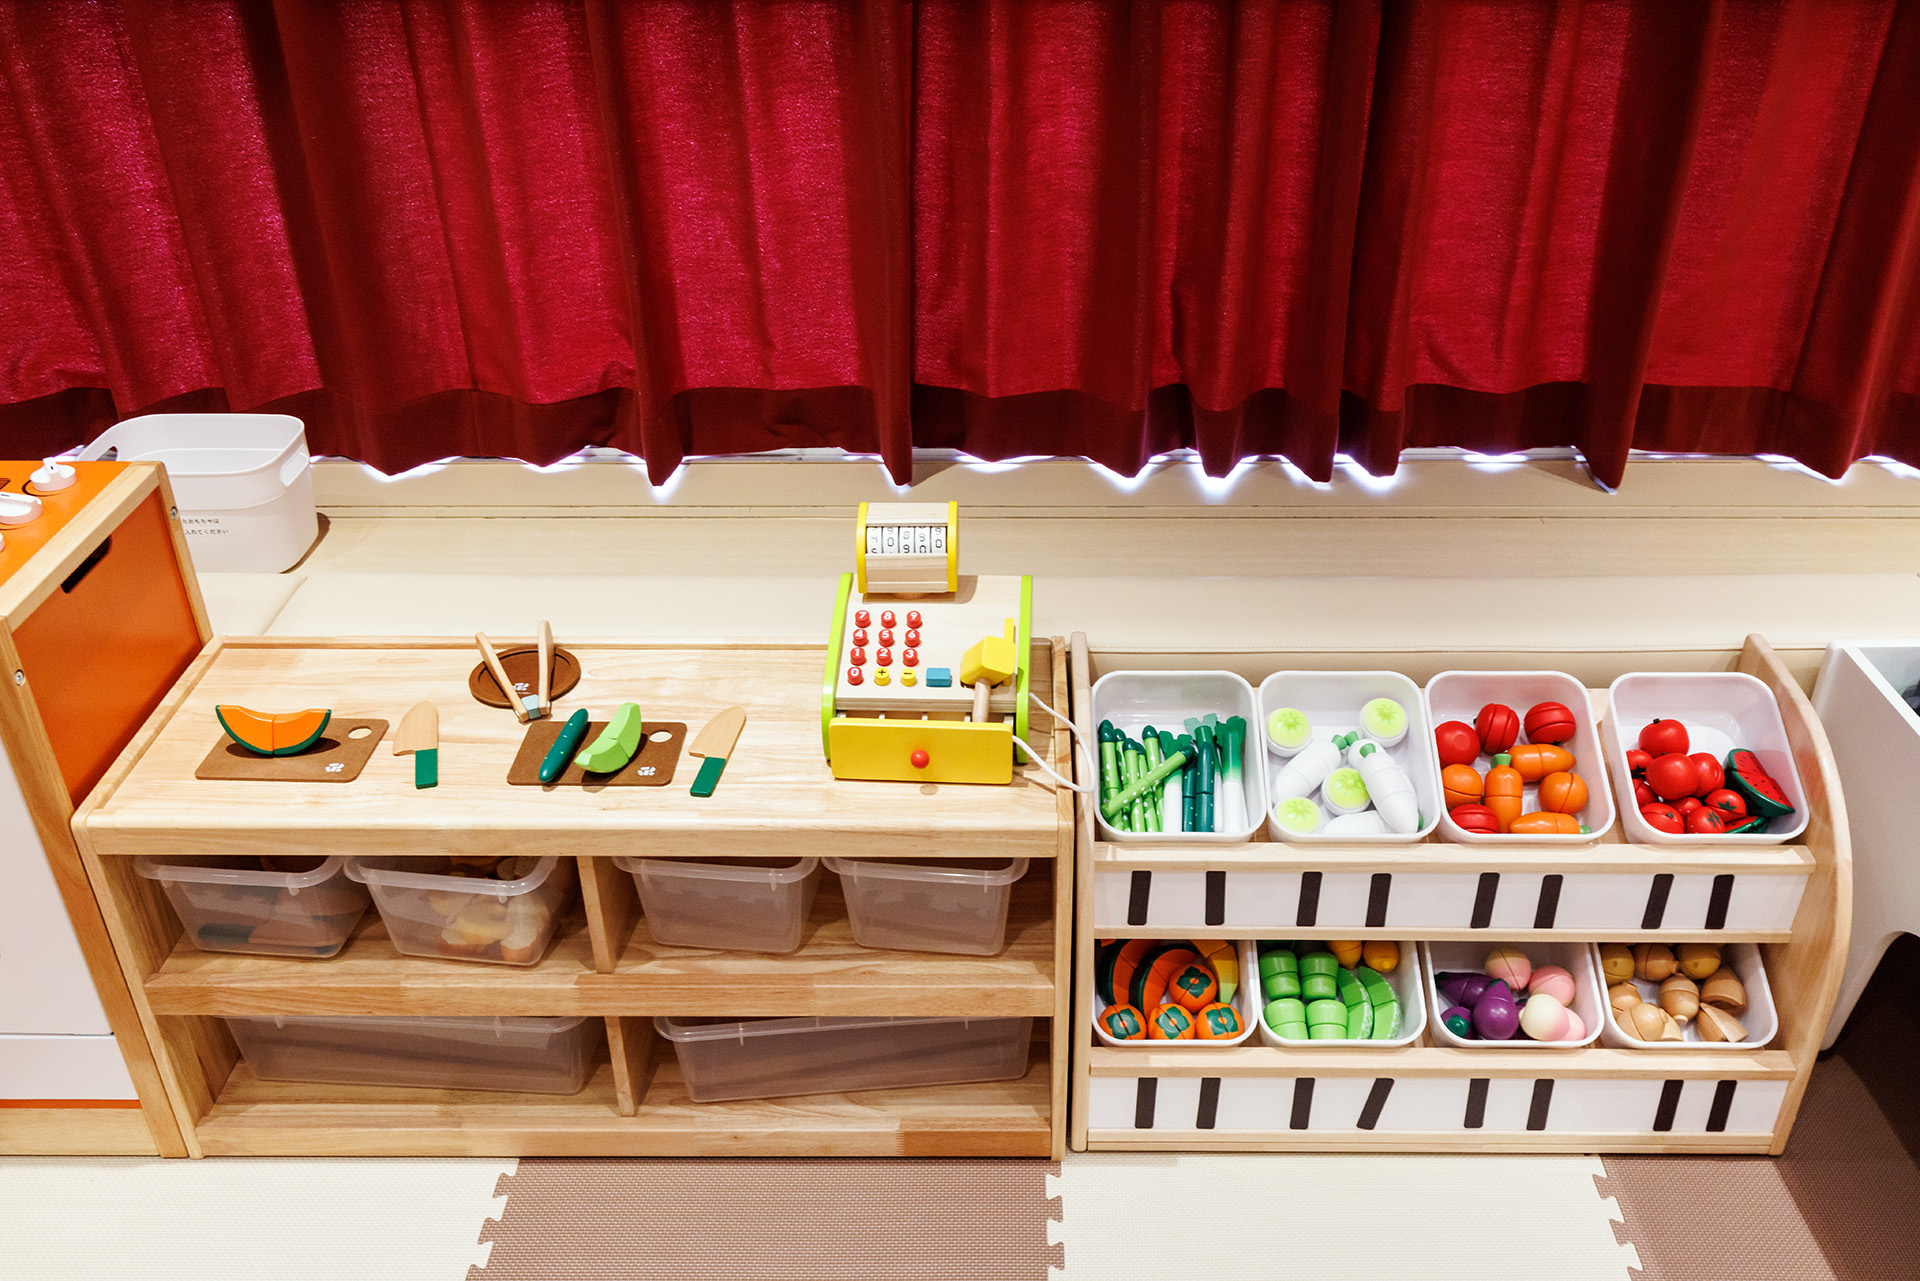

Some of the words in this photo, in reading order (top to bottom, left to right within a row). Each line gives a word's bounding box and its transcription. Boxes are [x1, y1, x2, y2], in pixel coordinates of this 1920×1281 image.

[884, 612, 892, 620] 8
[910, 612, 918, 620] 9
[881, 630, 889, 639] 5
[908, 631, 916, 639] 6
[880, 649, 888, 657] 2
[906, 650, 914, 658] 3
[851, 669, 859, 677] 0
